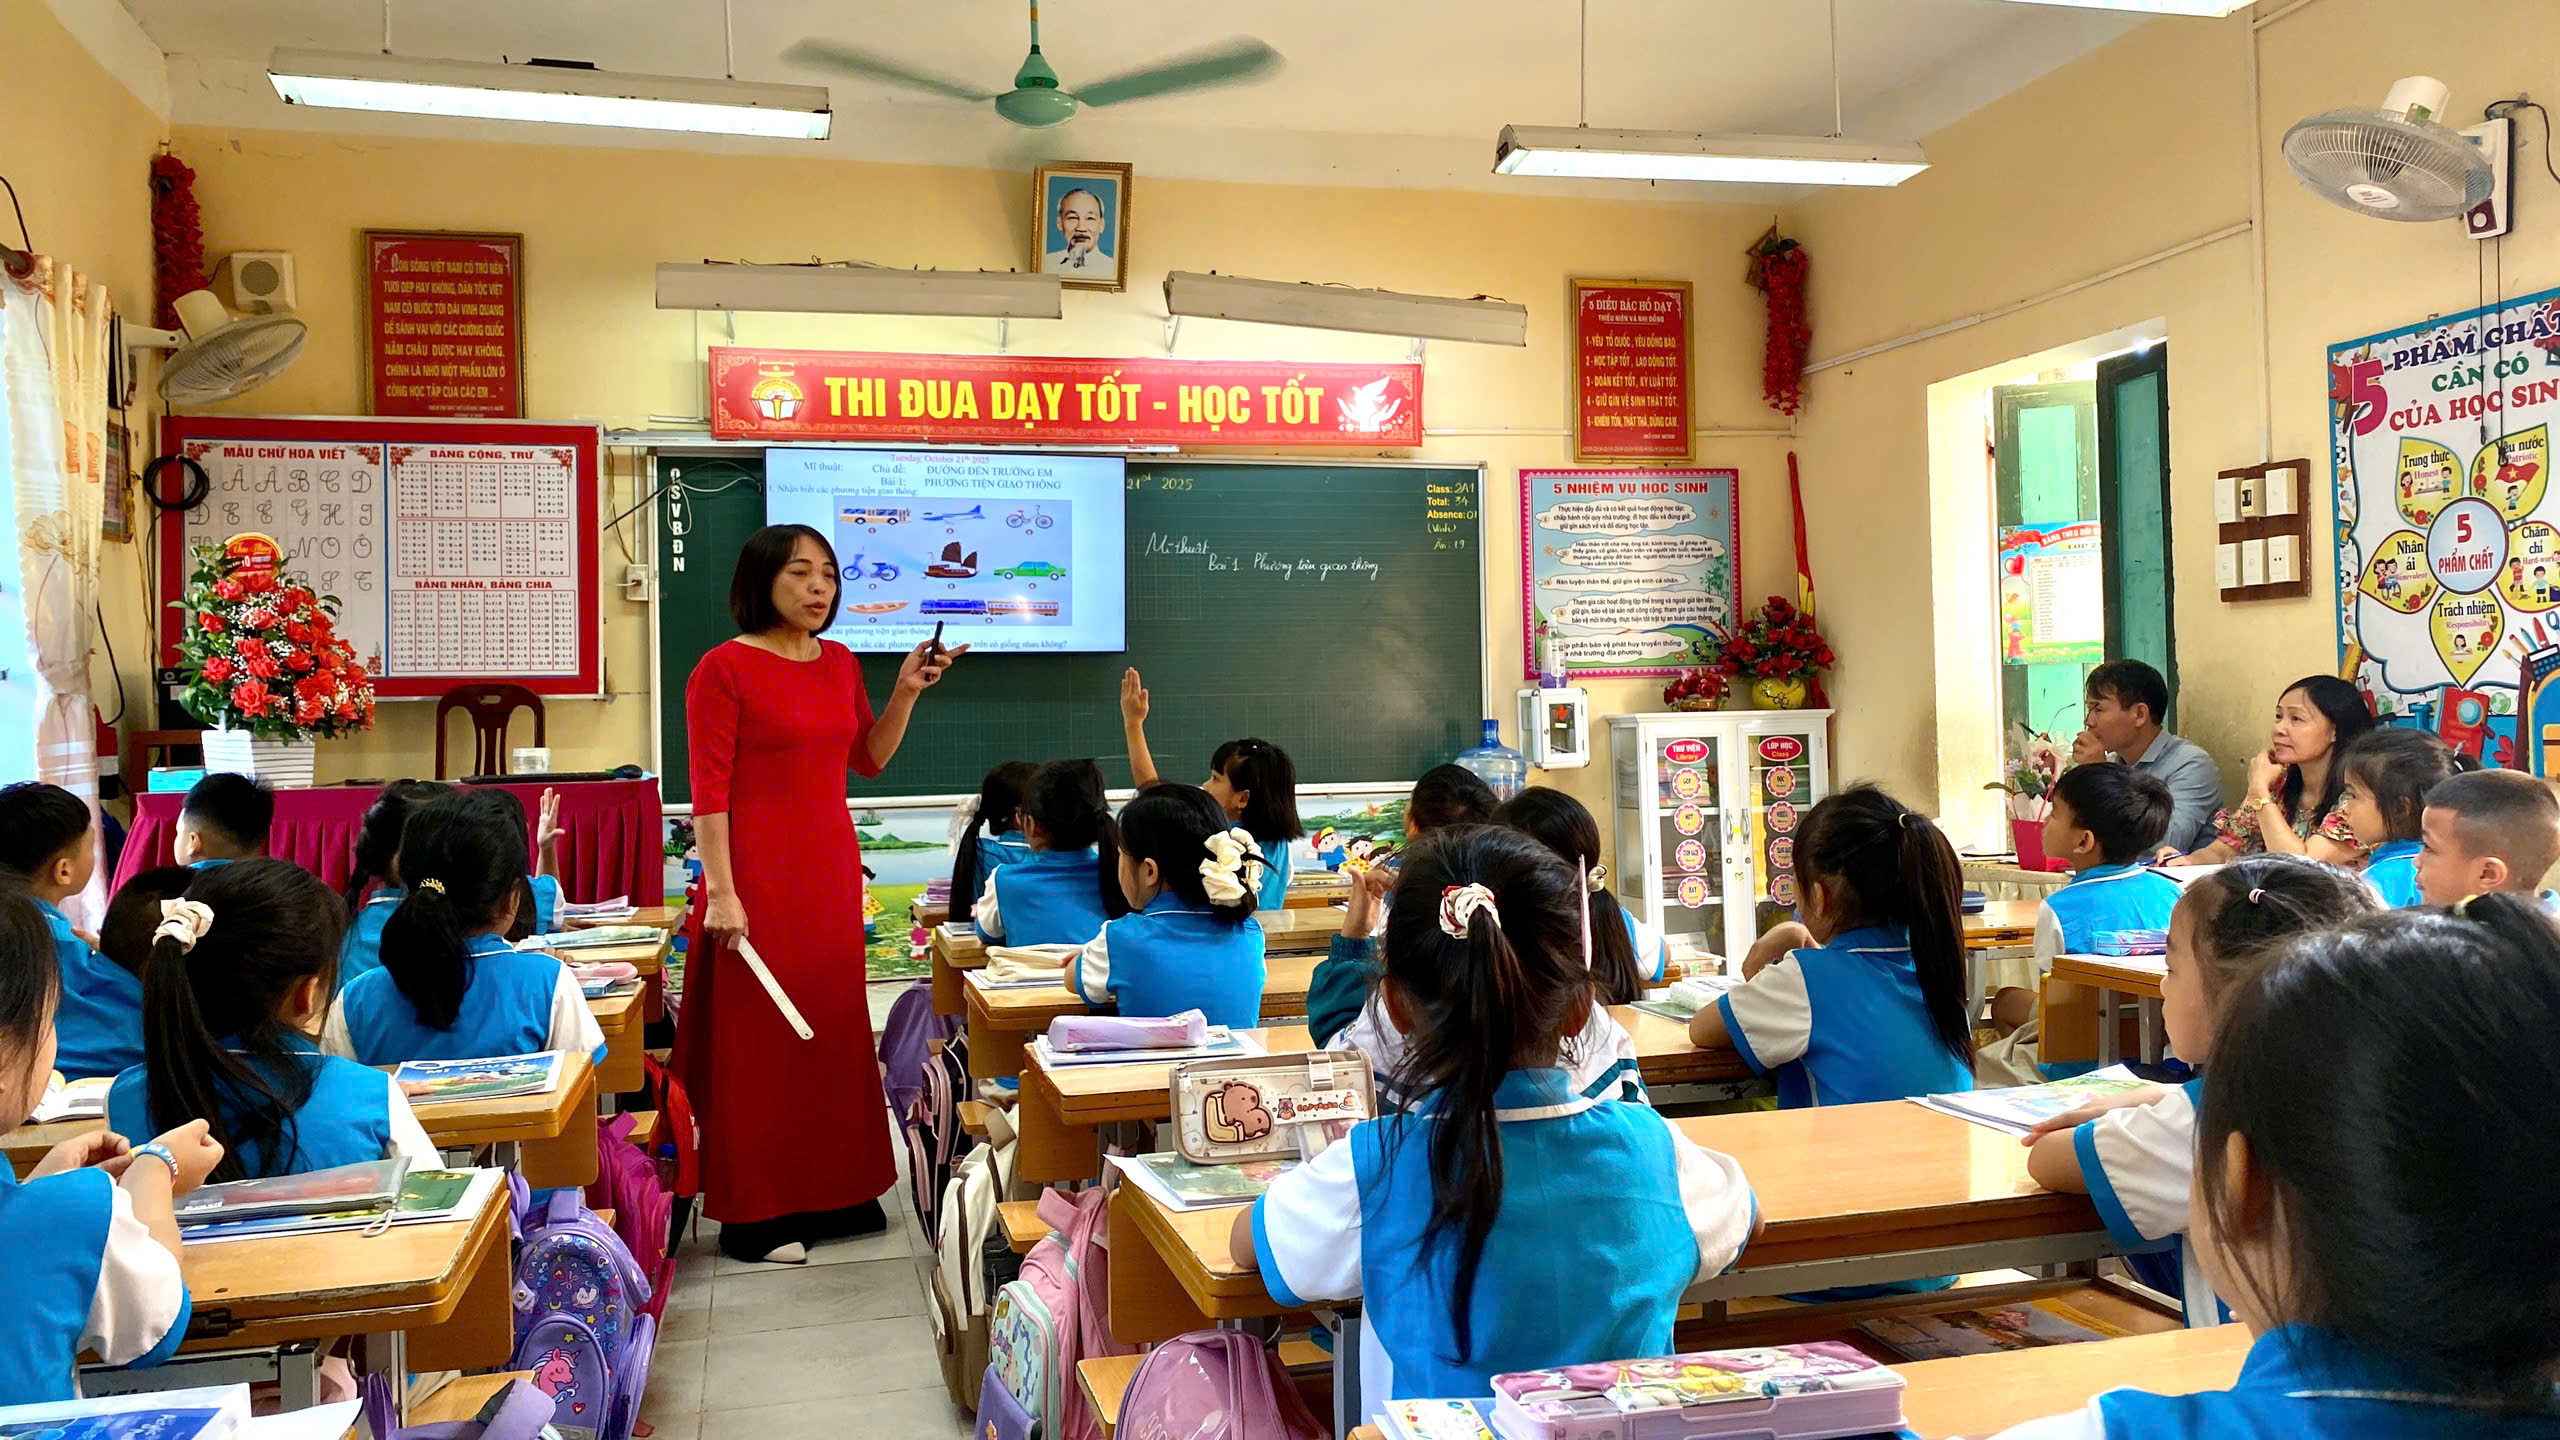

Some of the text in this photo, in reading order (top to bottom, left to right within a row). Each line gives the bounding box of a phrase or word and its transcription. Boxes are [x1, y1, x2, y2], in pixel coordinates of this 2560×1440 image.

[2432, 351, 2529, 392] CẦN CÓ
[2352, 359, 2388, 436] 5
[2393, 329, 2475, 371] PHẨM
[824, 376, 885, 418] THI
[899, 380, 978, 422] ĐUA
[991, 381, 1063, 429] DẠY
[1076, 370, 1142, 423] TỐT
[1179, 385, 1249, 432] HỌC
[1262, 373, 1324, 424] TỐT
[2389, 400, 2441, 432] CỦA
[2449, 390, 2503, 421] HỌC
[2518, 435, 2544, 451] nước
[223, 446, 346, 459] MẪU CHỮ HOA VIẾT
[2403, 450, 2450, 468] Trung thực
[2414, 469, 2439, 480] Honest
[1162, 477, 1193, 491] 2025
[1426, 484, 1453, 494] Class:
[1554, 481, 1708, 497] 5 NHIỆM VỤ HỌC SINH
[1426, 496, 1450, 506] Total:
[1427, 510, 1465, 519] Absence:
[2457, 513, 2473, 543] 5
[2521, 526, 2550, 539] Chăm
[2396, 540, 2424, 555] Nhân
[2406, 556, 2416, 571] ái
[2439, 545, 2494, 574] PHẨM CHẤT
[415, 578, 553, 590] BẢNG NHÂN, BẢNG CHIA
[2437, 600, 2496, 619] Trách nhiệm
[1686, 743, 1701, 753] VIỆN
[1767, 742, 1793, 751] LỚP HỌC
